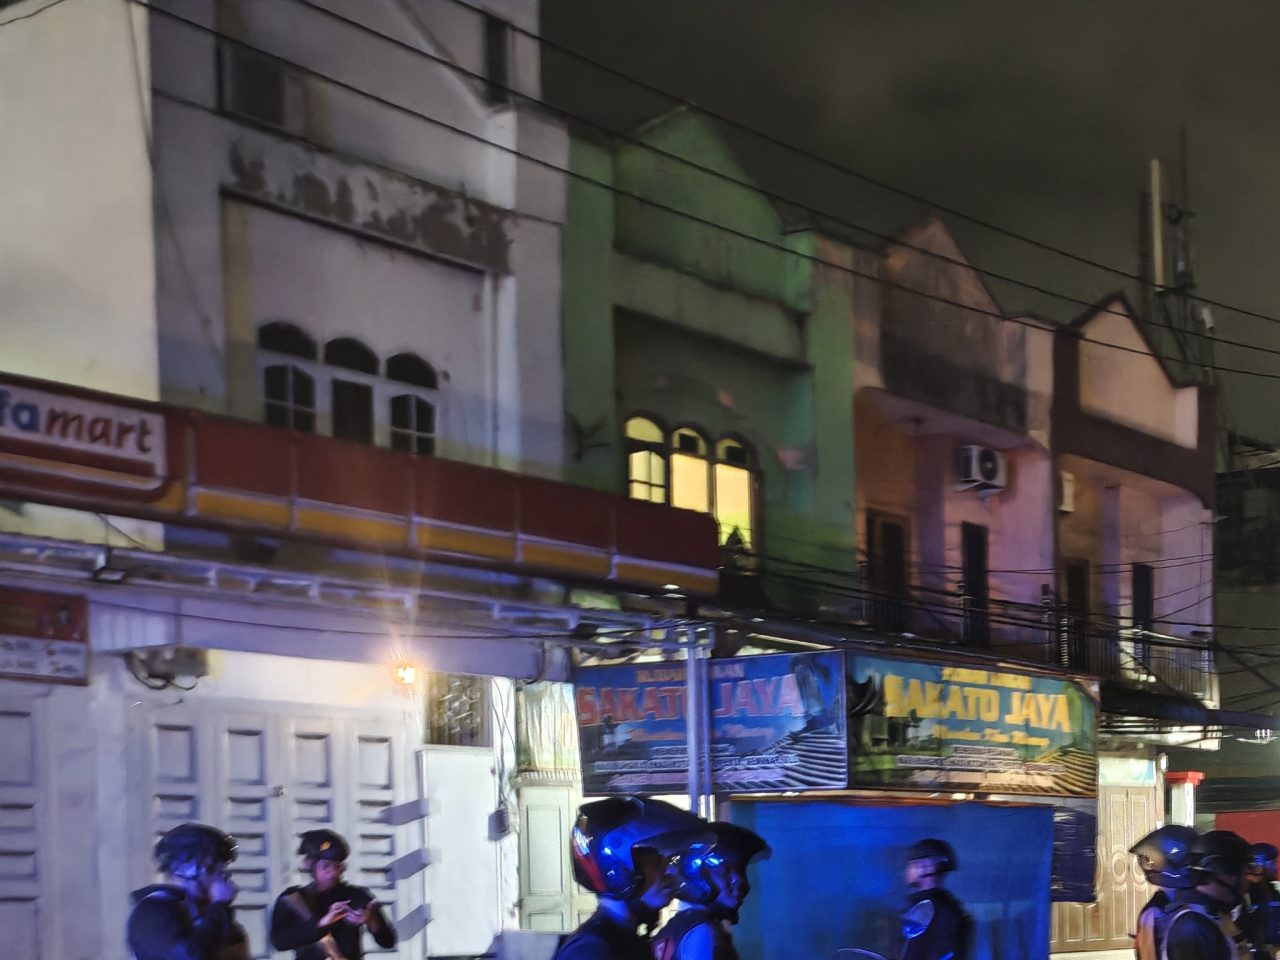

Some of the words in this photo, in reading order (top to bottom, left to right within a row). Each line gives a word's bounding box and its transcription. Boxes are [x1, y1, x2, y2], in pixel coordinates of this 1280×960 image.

[577, 684, 700, 727] SAKAT
[713, 673, 805, 718] JAYA
[884, 674, 999, 722] SAKATO
[1005, 691, 1072, 733] JAYA
